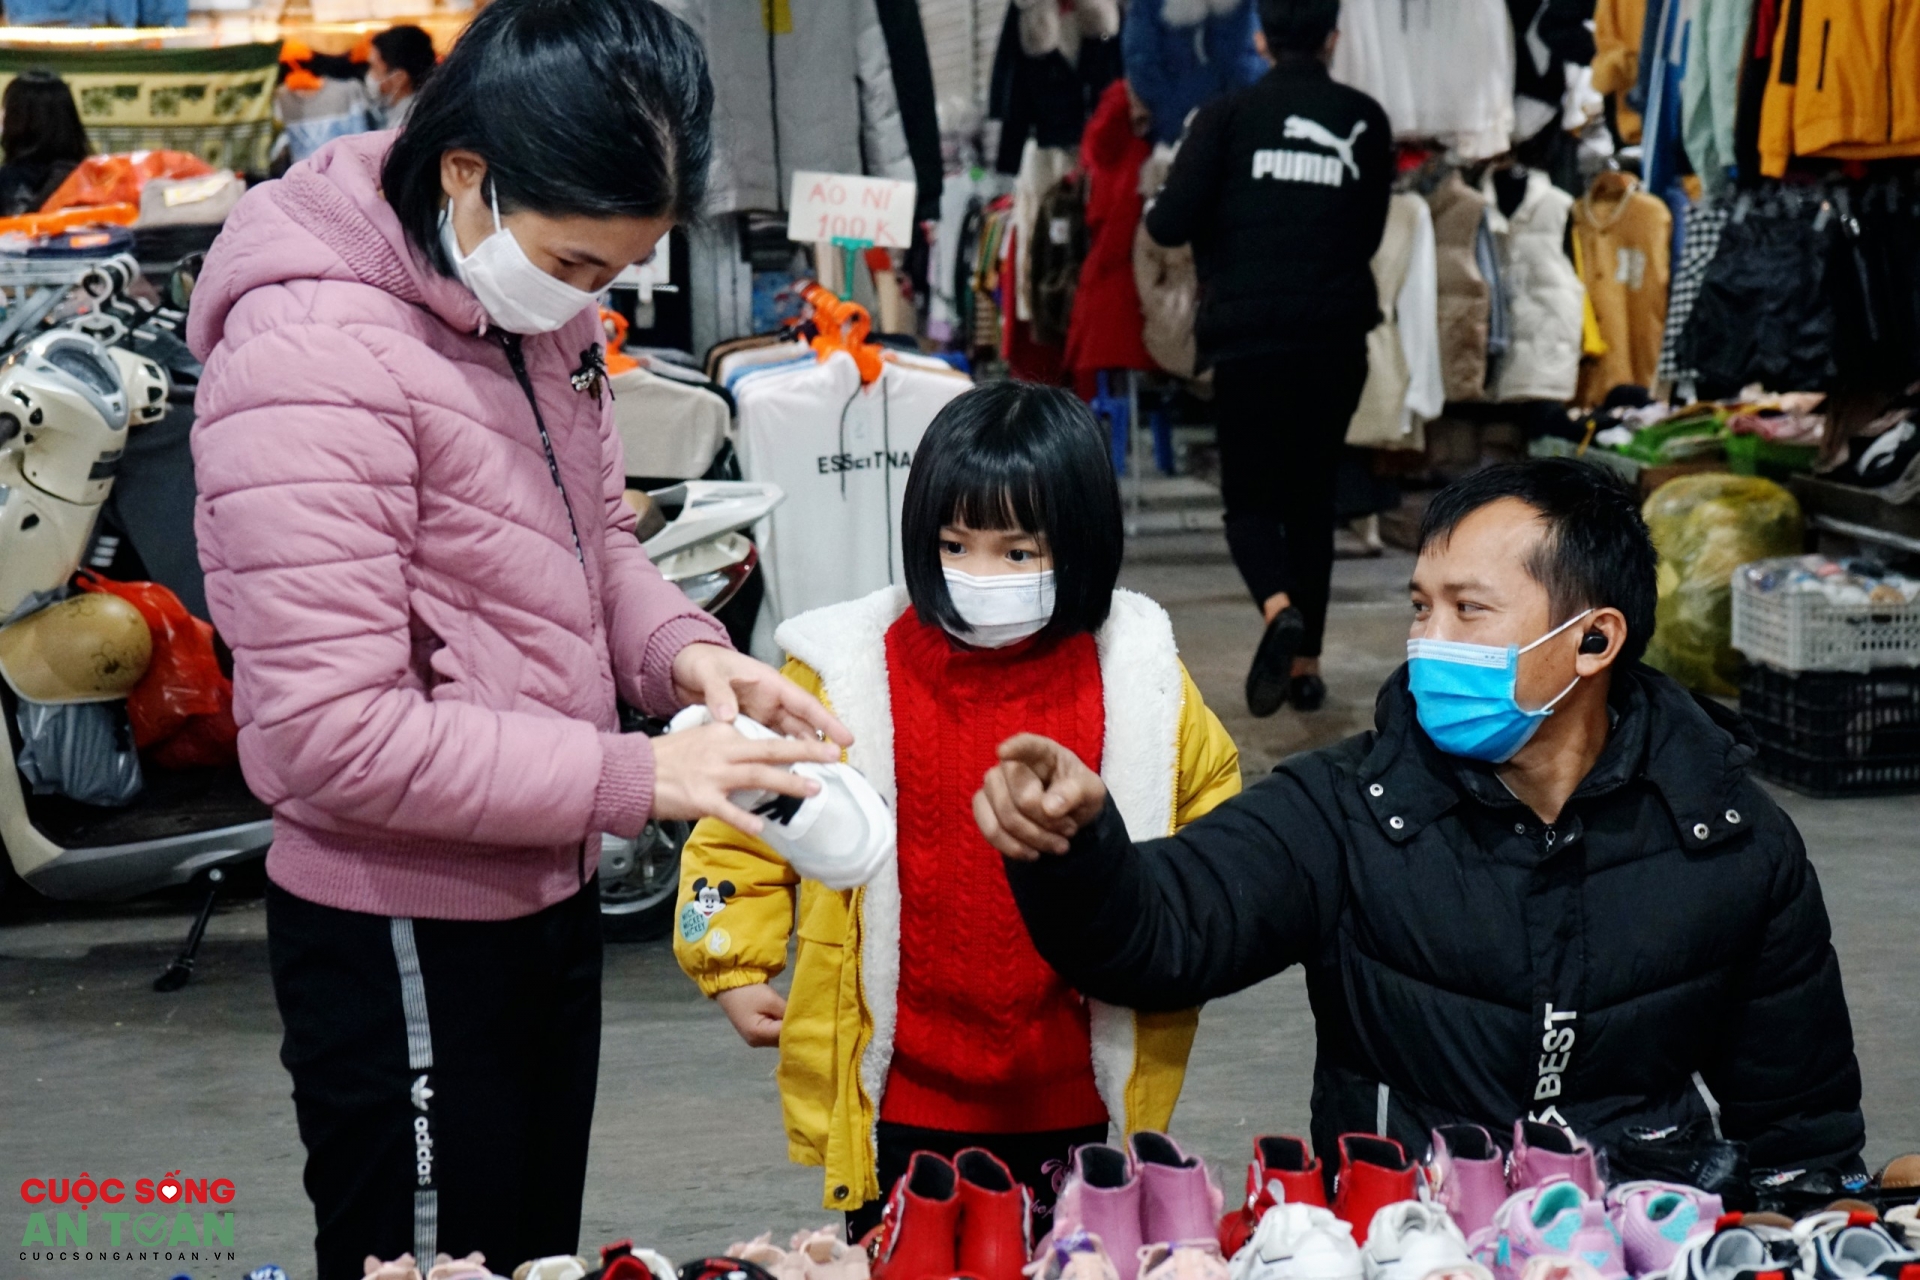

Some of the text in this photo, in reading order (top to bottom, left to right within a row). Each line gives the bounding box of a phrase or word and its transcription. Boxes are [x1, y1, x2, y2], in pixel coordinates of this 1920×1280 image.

[1251, 148, 1344, 187] PUMA
[1534, 1003, 1577, 1100] BEST
[413, 1116, 434, 1186] adidas
